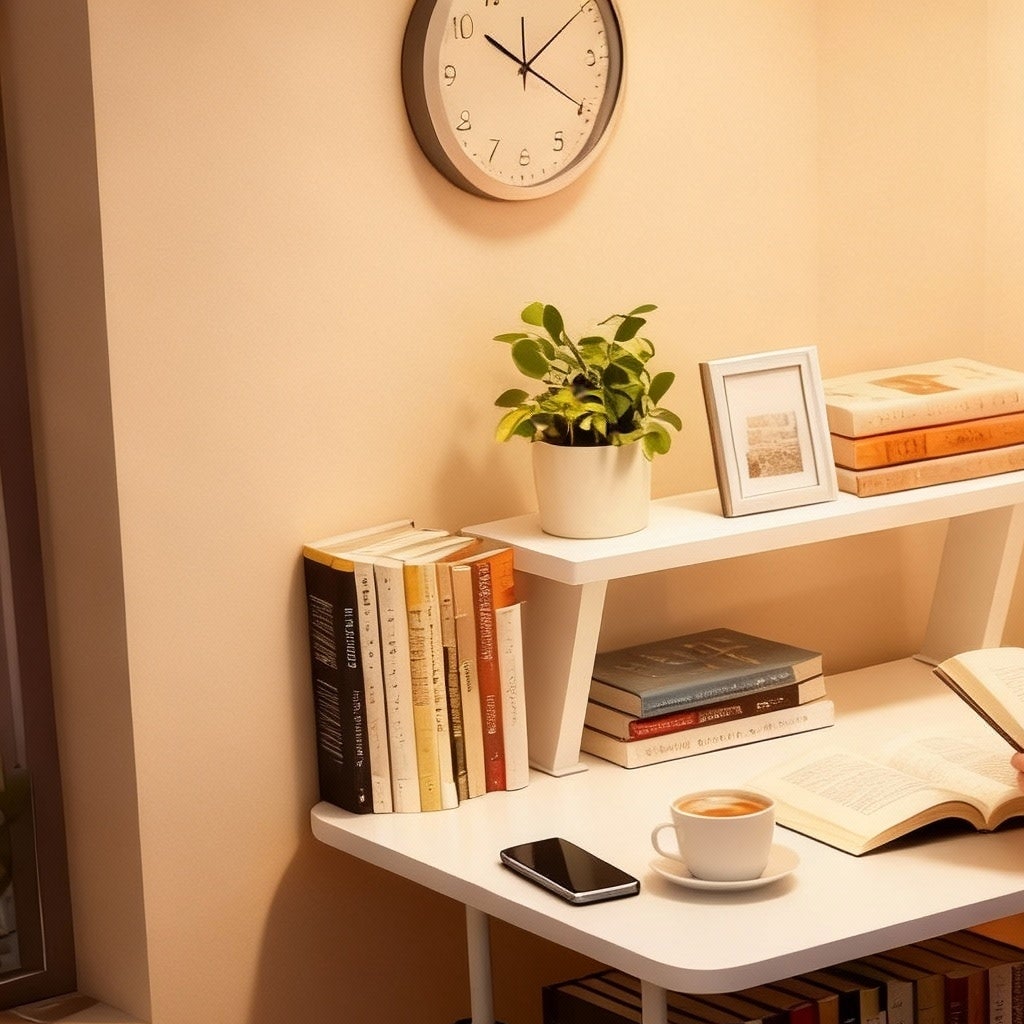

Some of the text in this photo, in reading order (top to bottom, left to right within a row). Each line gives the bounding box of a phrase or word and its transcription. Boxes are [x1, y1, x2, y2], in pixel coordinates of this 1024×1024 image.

[453, 14, 474, 40] 10
[445, 64, 457, 86] 9
[456, 110, 472, 131] 8
[489, 139, 500, 163] 7
[552, 131, 564, 151] 5
[519, 148, 531, 167] 6
